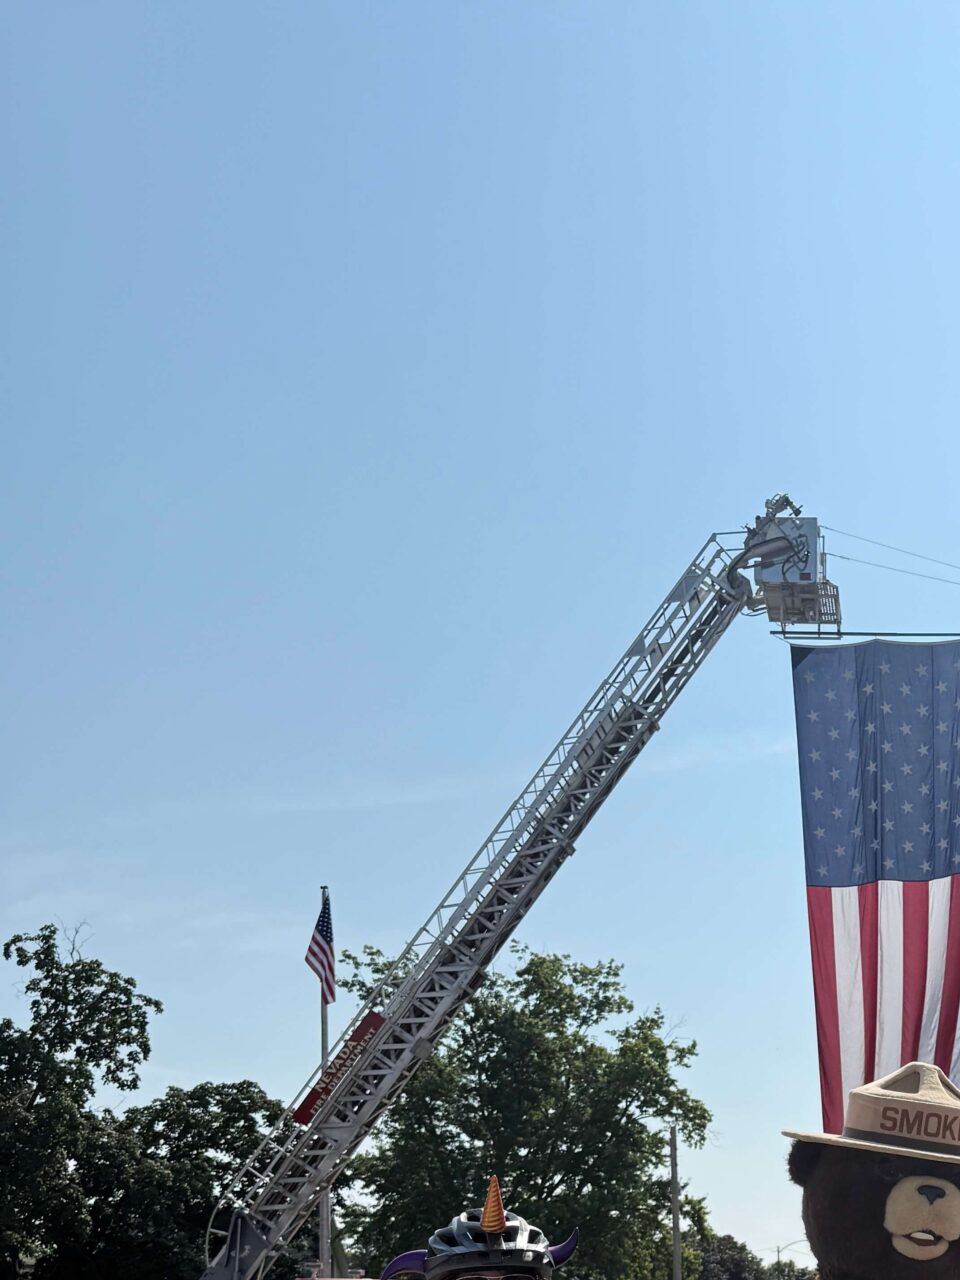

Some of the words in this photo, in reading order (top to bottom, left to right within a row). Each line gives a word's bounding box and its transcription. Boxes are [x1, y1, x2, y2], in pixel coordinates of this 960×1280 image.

[310, 1093, 328, 1115] FIRE
[328, 1027, 377, 1091] DEPARTMENT
[315, 1040, 358, 1092] NEVADA
